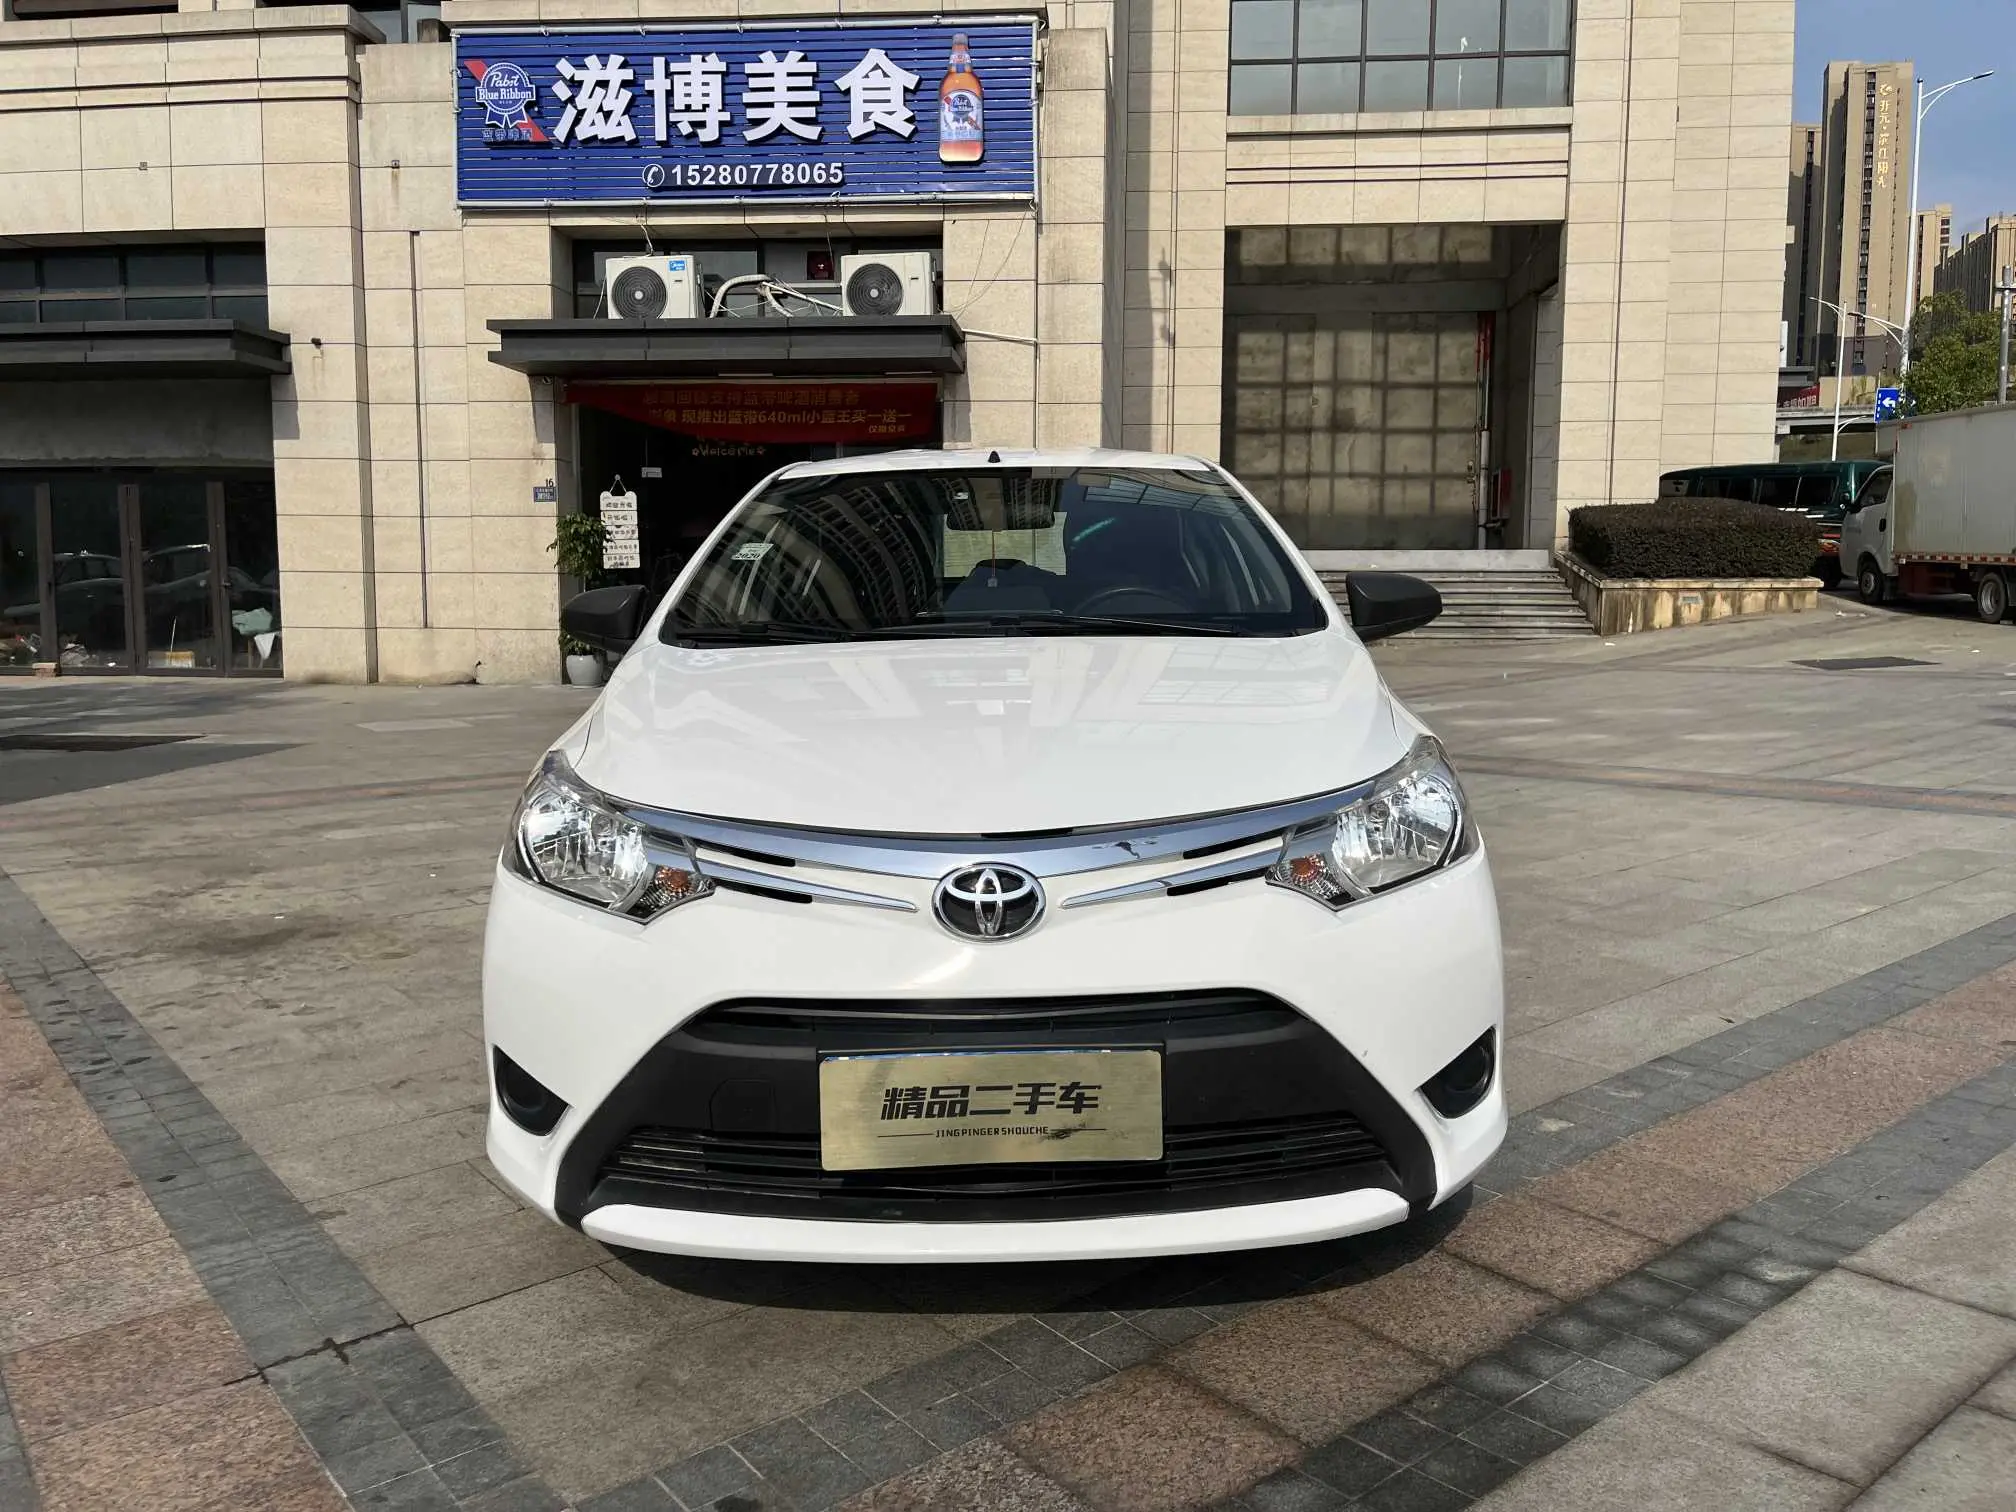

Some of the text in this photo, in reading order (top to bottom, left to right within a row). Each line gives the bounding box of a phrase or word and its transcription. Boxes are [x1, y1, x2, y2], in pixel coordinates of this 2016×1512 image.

[490, 71, 520, 87] Pabst
[478, 87, 532, 100] Blue Ribbon
[552, 48, 921, 143] 滋博美食
[671, 163, 844, 186] 15280778065
[545, 478, 554, 488] 16
[880, 1081, 1103, 1121] 精品二手车
